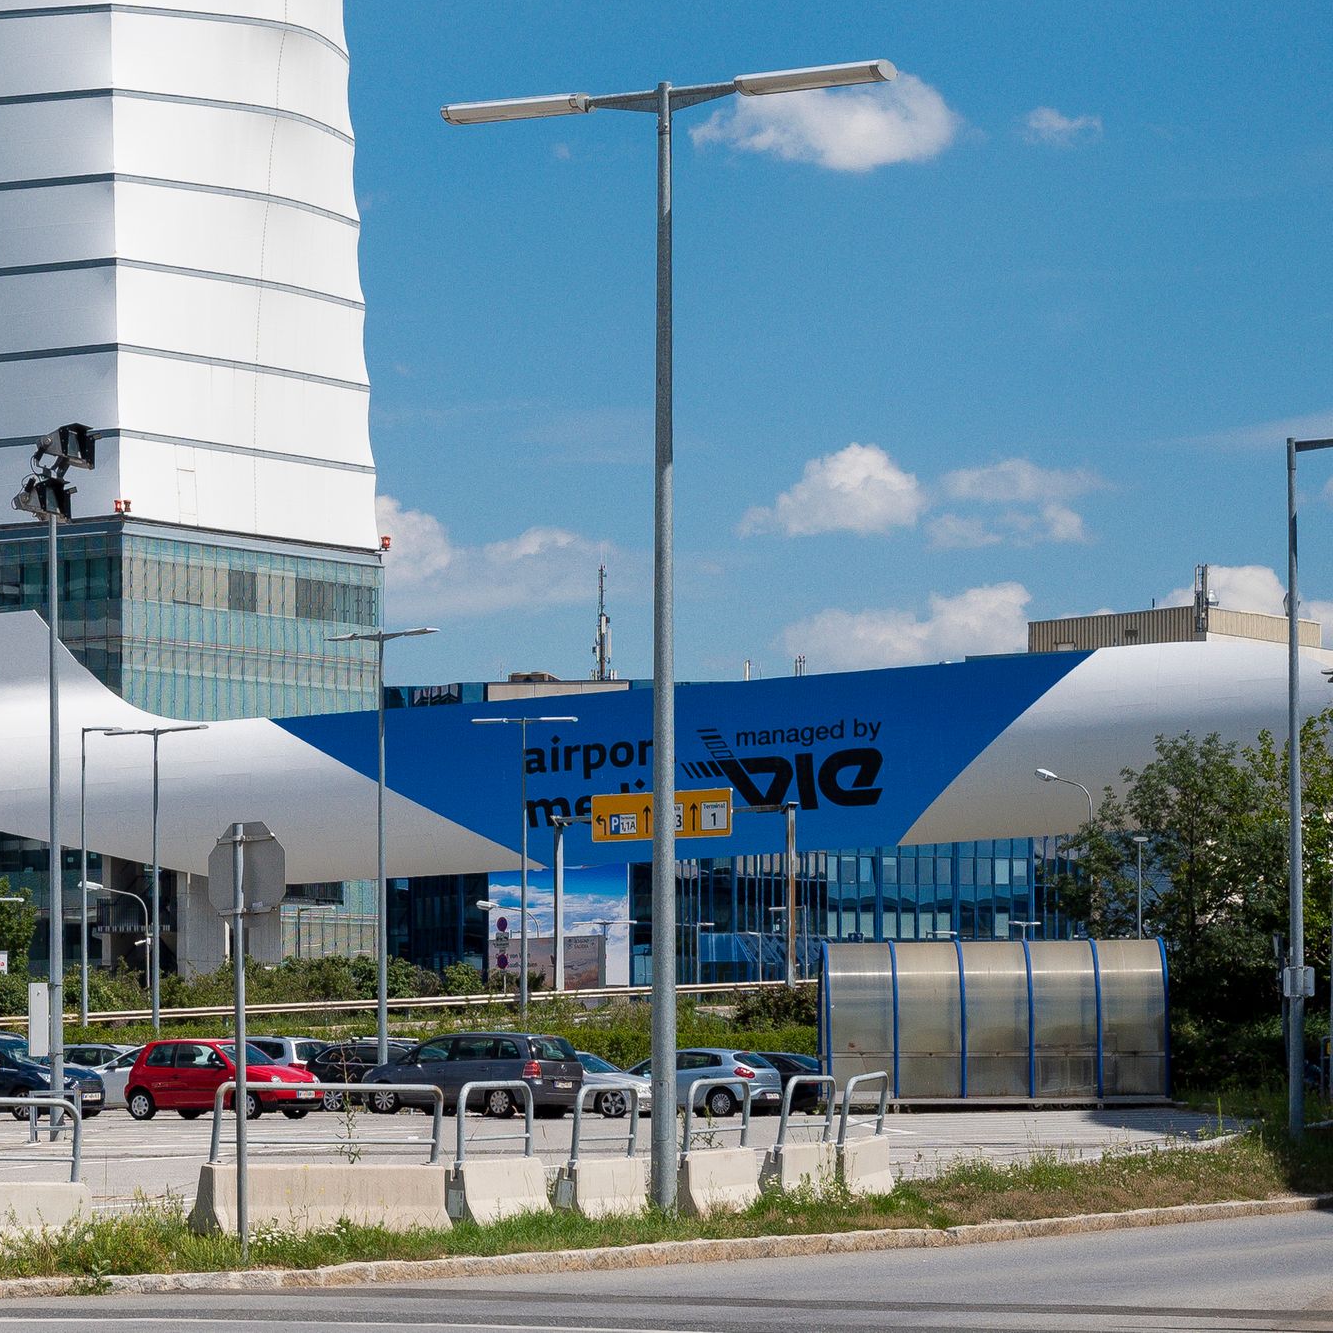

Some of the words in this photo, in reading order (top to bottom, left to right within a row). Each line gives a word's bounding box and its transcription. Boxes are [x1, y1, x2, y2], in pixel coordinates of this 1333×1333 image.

[735, 719, 845, 747] managed
[852, 718, 883, 742] by
[525, 735, 676, 779] airpor
[611, 817, 619, 830] P
[711, 812, 717, 826] 1
